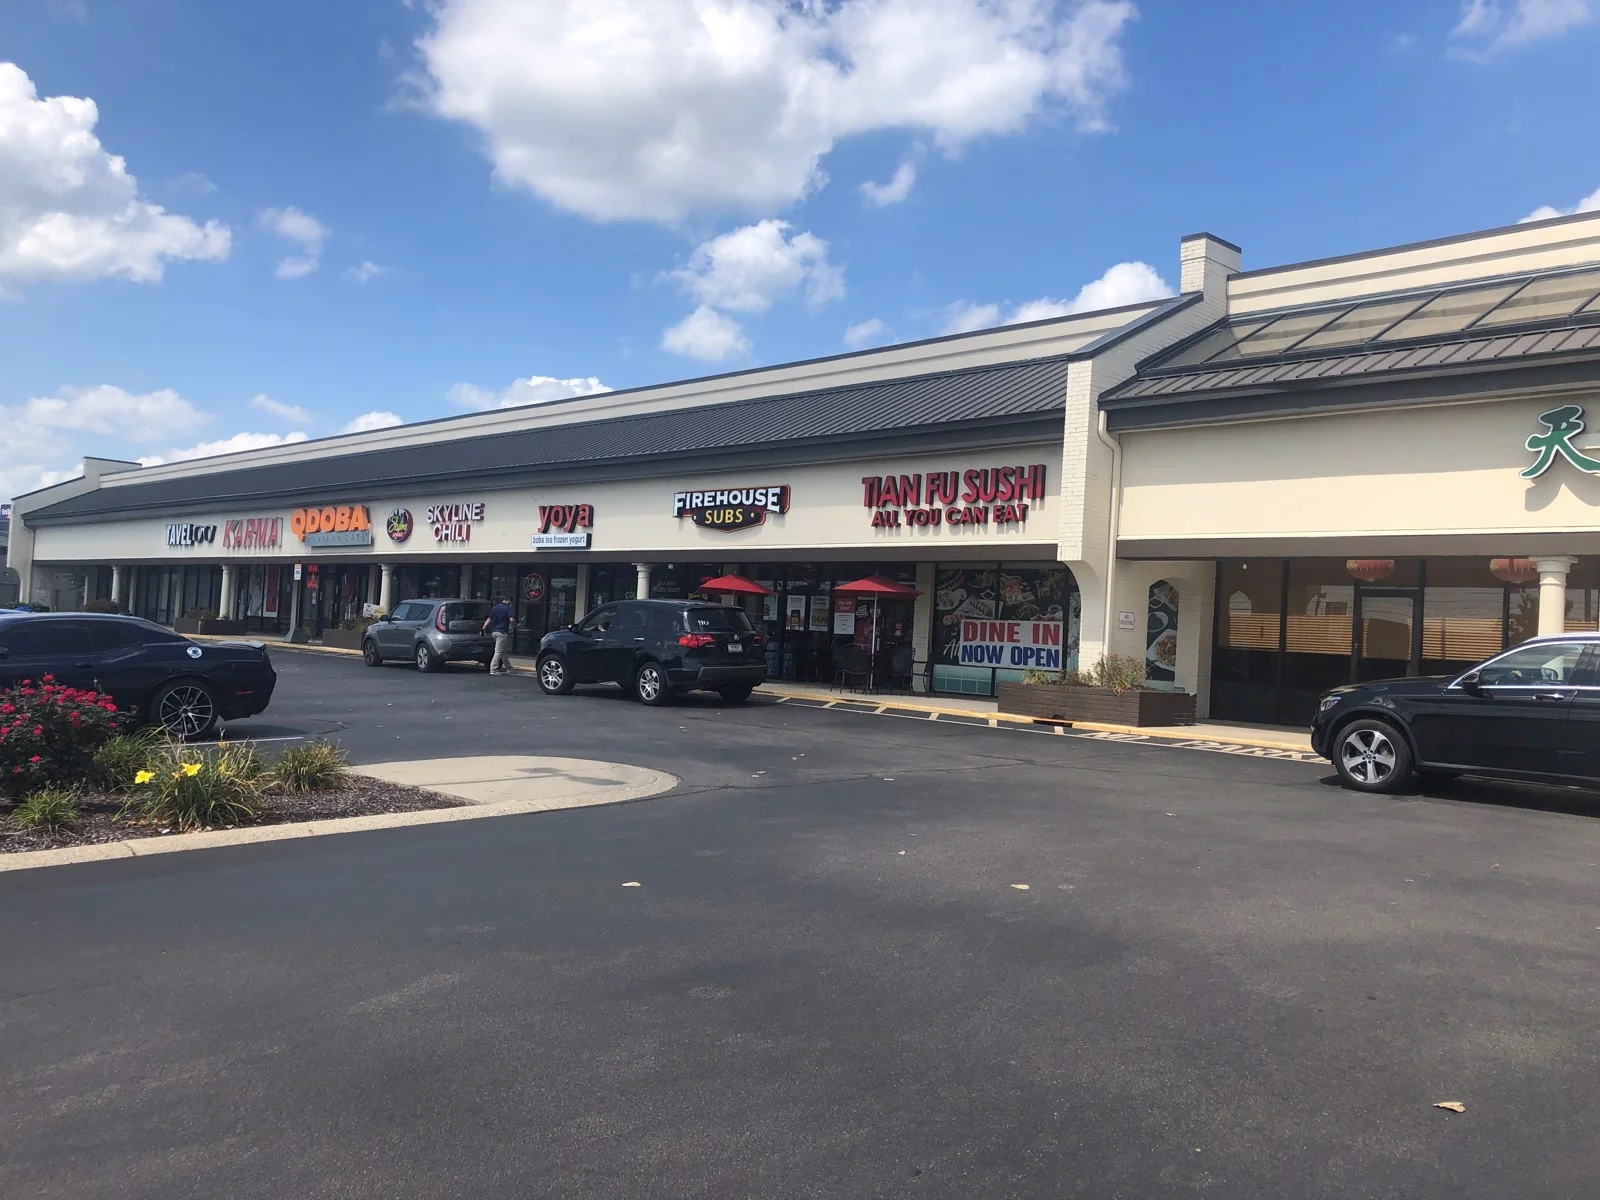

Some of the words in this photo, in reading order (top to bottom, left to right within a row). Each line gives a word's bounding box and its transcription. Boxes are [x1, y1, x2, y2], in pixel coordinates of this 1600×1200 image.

[862, 474, 921, 507] TIAN
[925, 471, 959, 505] FU
[962, 464, 1046, 503] SUSHI
[426, 503, 484, 523] SKYLINE
[673, 486, 781, 517] FIREHOUSE
[290, 504, 369, 542] QDOBA
[537, 503, 594, 533] yoya
[705, 508, 743, 524] SUBS
[871, 510, 901, 527] ALL
[904, 508, 941, 526] YOU
[945, 506, 989, 525] CAN
[993, 504, 1029, 523] EAT
[222, 517, 284, 548] KARMA
[433, 523, 471, 541] CHILI
[533, 536, 544, 544] boba
[553, 535, 568, 543] frozen
[569, 535, 585, 545] yogurt
[963, 621, 1021, 643] DINE
[1032, 623, 1060, 646] IN
[961, 644, 1004, 664] NOW
[1010, 645, 1060, 668] OPEN
